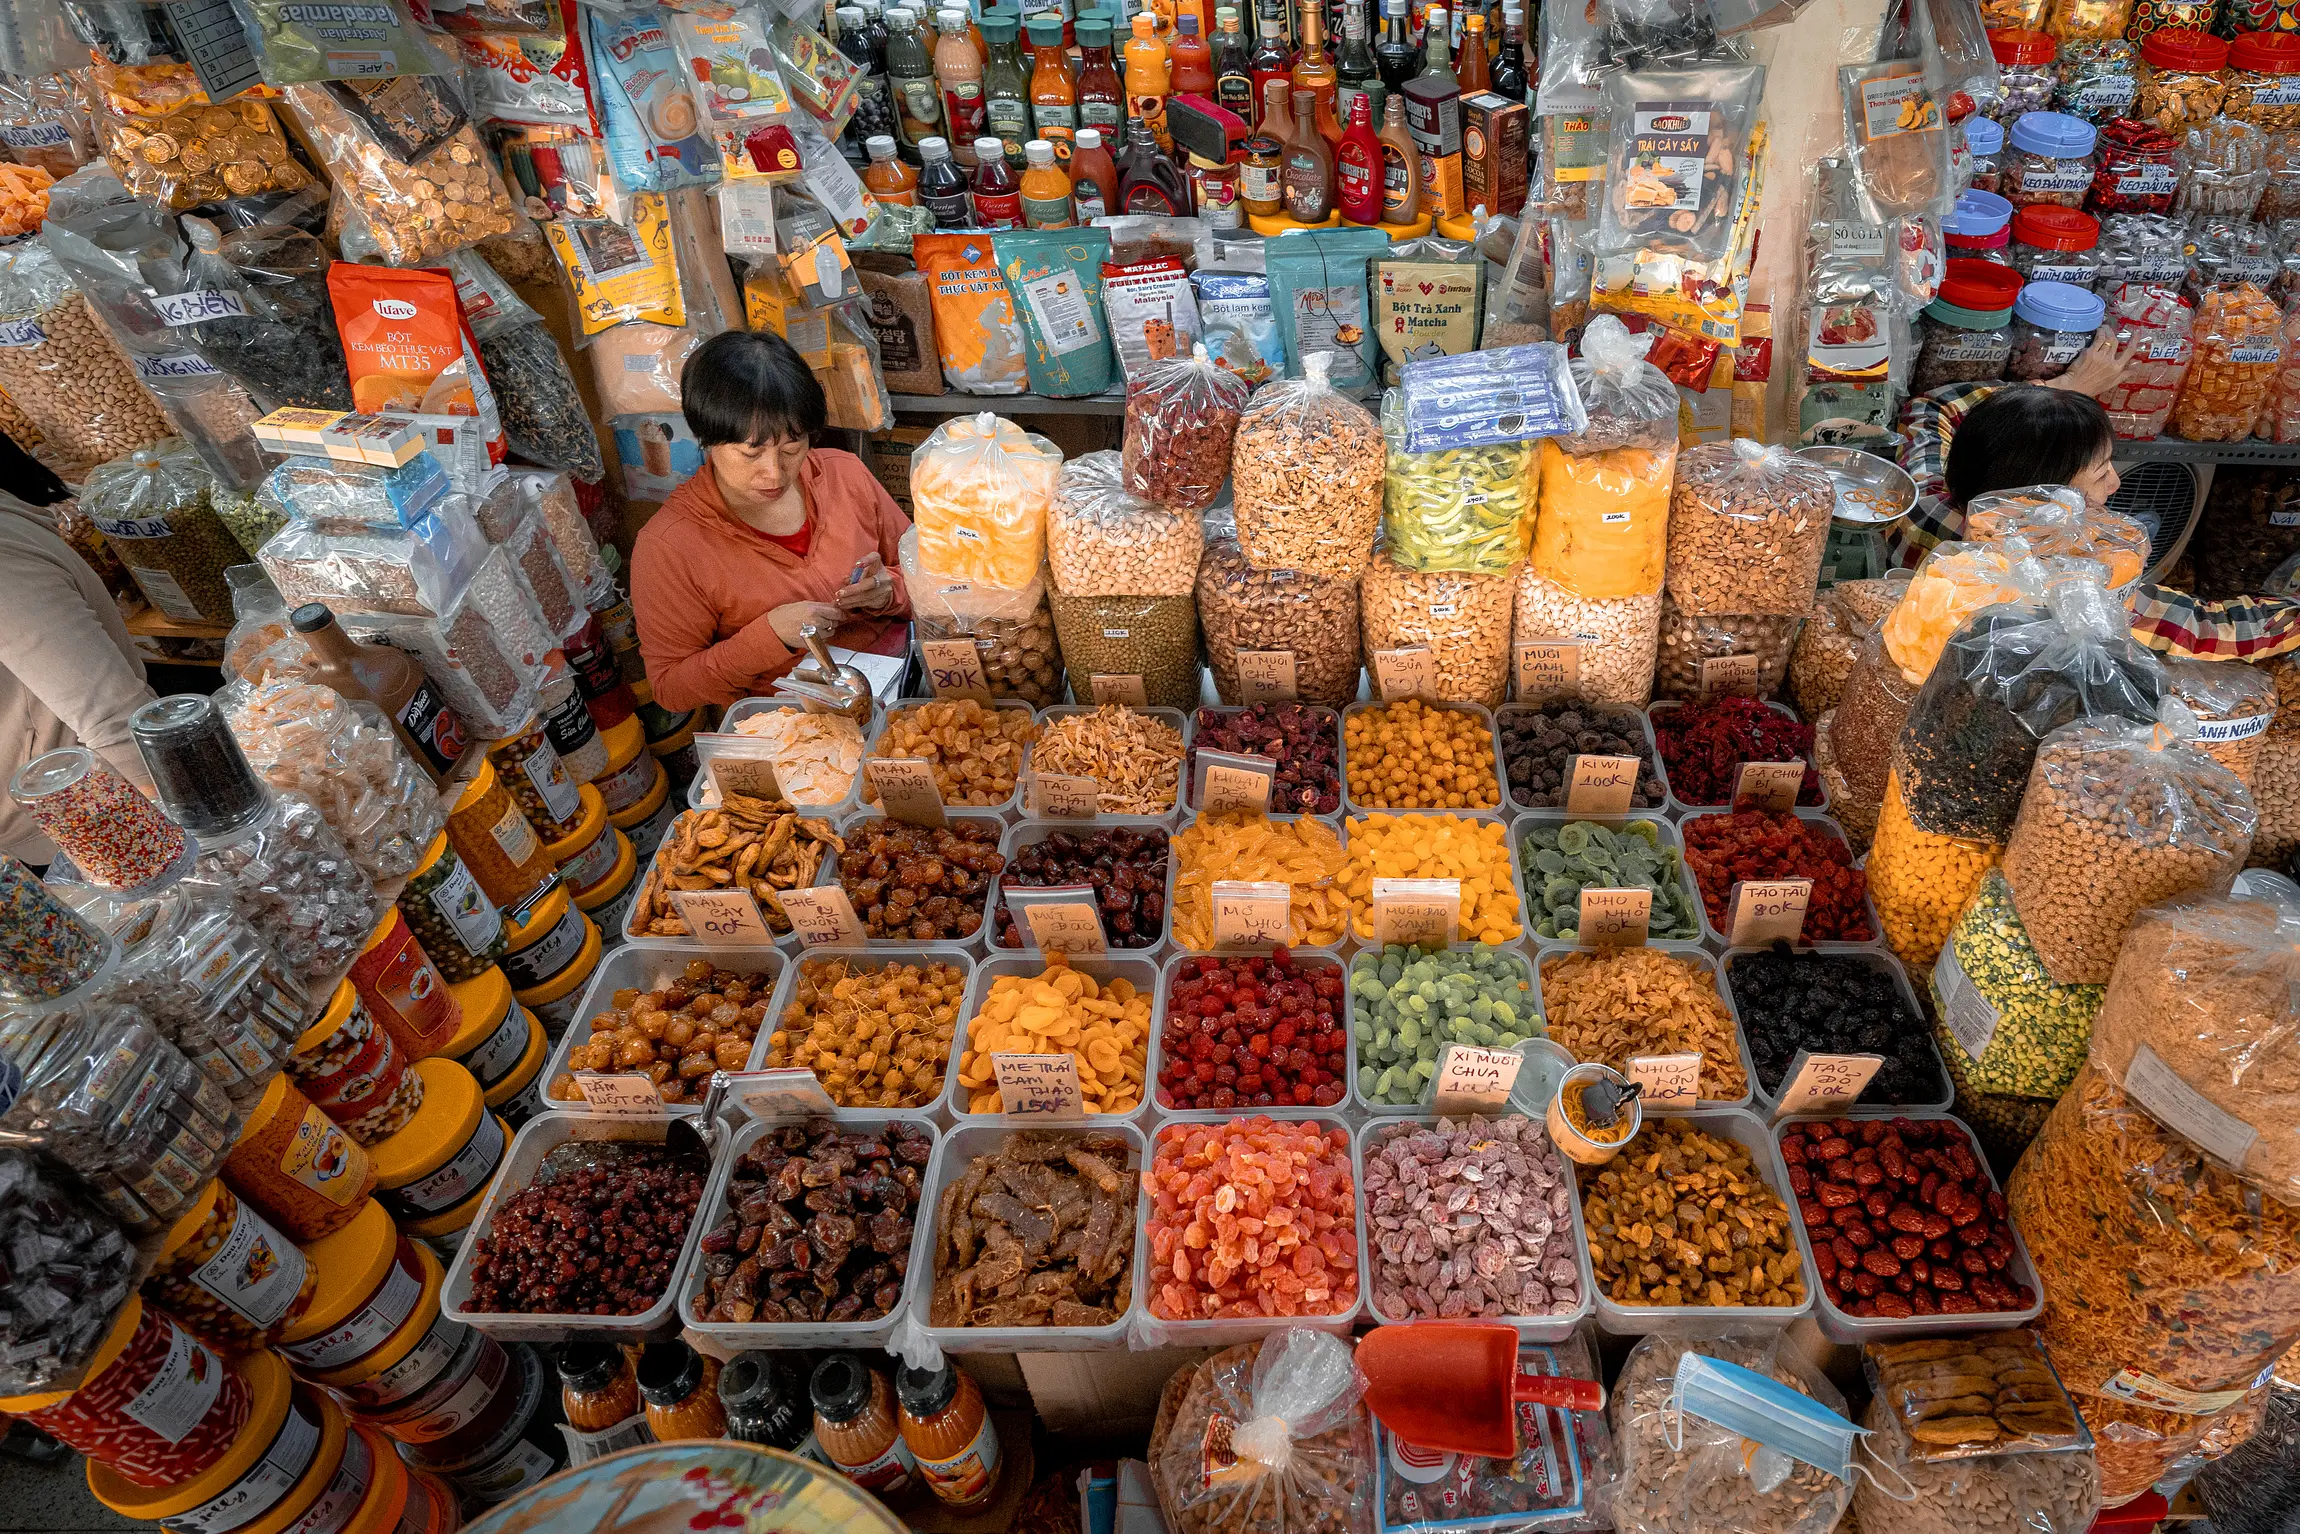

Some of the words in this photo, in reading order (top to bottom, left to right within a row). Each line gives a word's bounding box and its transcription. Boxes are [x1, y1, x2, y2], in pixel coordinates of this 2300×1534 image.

[317, 27, 387, 41] Australian
[1638, 137, 1656, 152] TRÁI
[1658, 137, 1678, 152] CÂY
[1680, 136, 1699, 152] SẤY
[1285, 169, 1322, 182] Chocolate
[1338, 162, 1369, 181] HERSHEY'S
[1081, 203, 1103, 213] Guava
[1834, 225, 1848, 239] SÔ
[1123, 262, 1169, 273] MAFALAC
[940, 270, 961, 283] BỘT
[964, 269, 988, 281] KEM
[938, 284, 967, 297] THỰC
[970, 282, 989, 295] VẬT
[1134, 294, 1174, 304] Malaysia
[1393, 301, 1411, 314] Bột
[1413, 302, 1432, 314] Trà
[1435, 302, 1462, 314] Xanh
[1408, 316, 1447, 327] Matcha
[386, 331, 412, 344] BỘT
[351, 342, 374, 352] KEM
[375, 343, 396, 353] BÉO
[430, 345, 453, 356] VẬT
[380, 354, 431, 370] MT35
[932, 668, 986, 691] 80K
[2229, 716, 2266, 738] NHÂN
[1755, 902, 1802, 916] 80K
[1001, 1063, 1033, 1072] ME
[1452, 1066, 1499, 1079] CHUA
[1001, 1076, 1043, 1085] CAM
[1808, 1085, 1850, 1098] 80K
[163, 1351, 179, 1376] Xian
